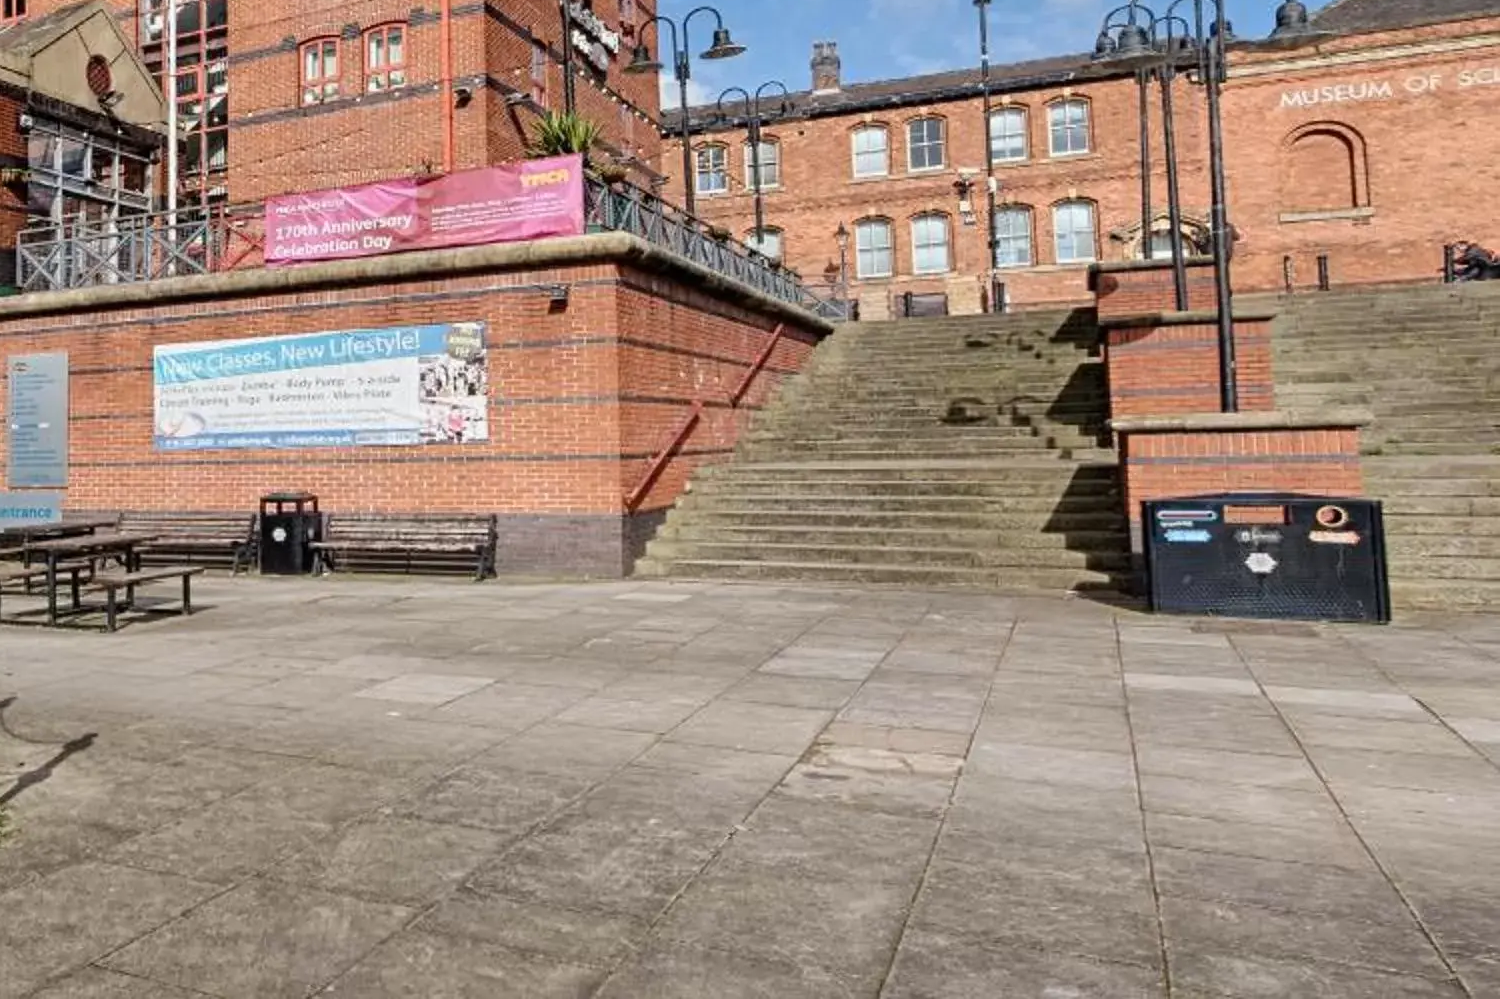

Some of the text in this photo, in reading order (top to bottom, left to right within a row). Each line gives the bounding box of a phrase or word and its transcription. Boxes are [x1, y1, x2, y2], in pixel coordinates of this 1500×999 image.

[1280, 81, 1393, 108] MUSEUM
[1404, 74, 1443, 93] OF
[275, 214, 413, 242] 170th Anniversary
[274, 235, 394, 260] Celebration Day
[207, 349, 277, 371] Classes,
[280, 343, 326, 362] New
[329, 329, 422, 357] Lifestyle!
